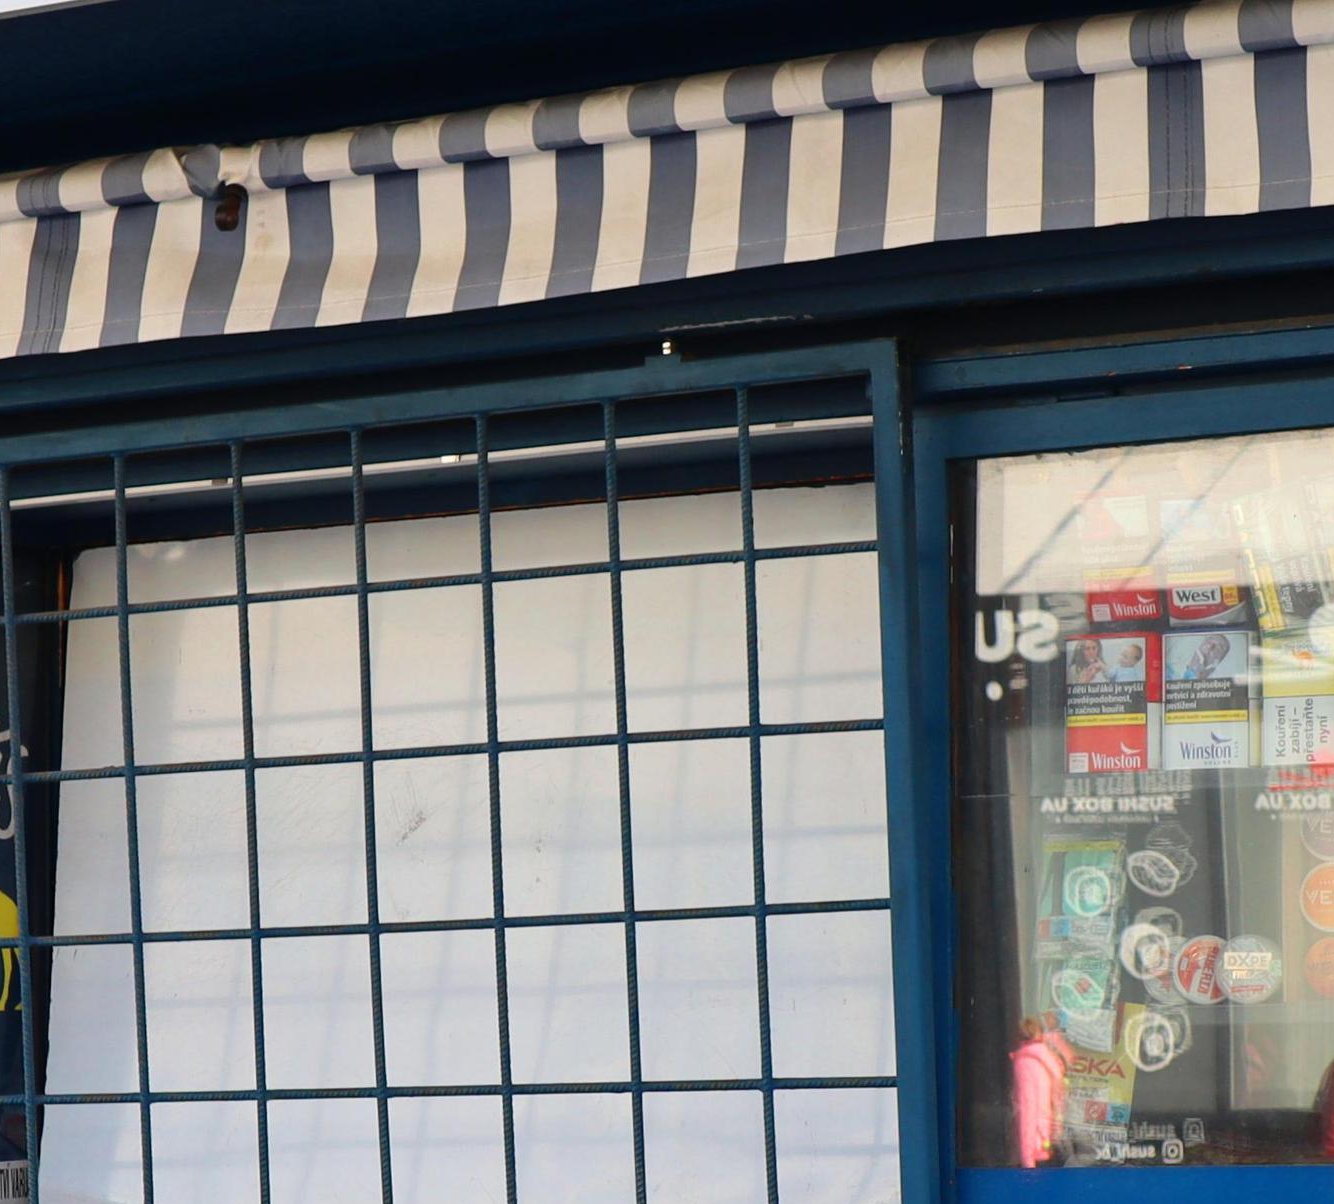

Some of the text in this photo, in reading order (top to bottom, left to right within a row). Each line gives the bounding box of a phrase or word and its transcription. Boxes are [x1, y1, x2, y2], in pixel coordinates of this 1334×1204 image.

[1175, 589, 1218, 603] West
[1113, 602, 1157, 617] Winston
[1180, 740, 1231, 761] Winston
[1092, 752, 1141, 769] Winston
